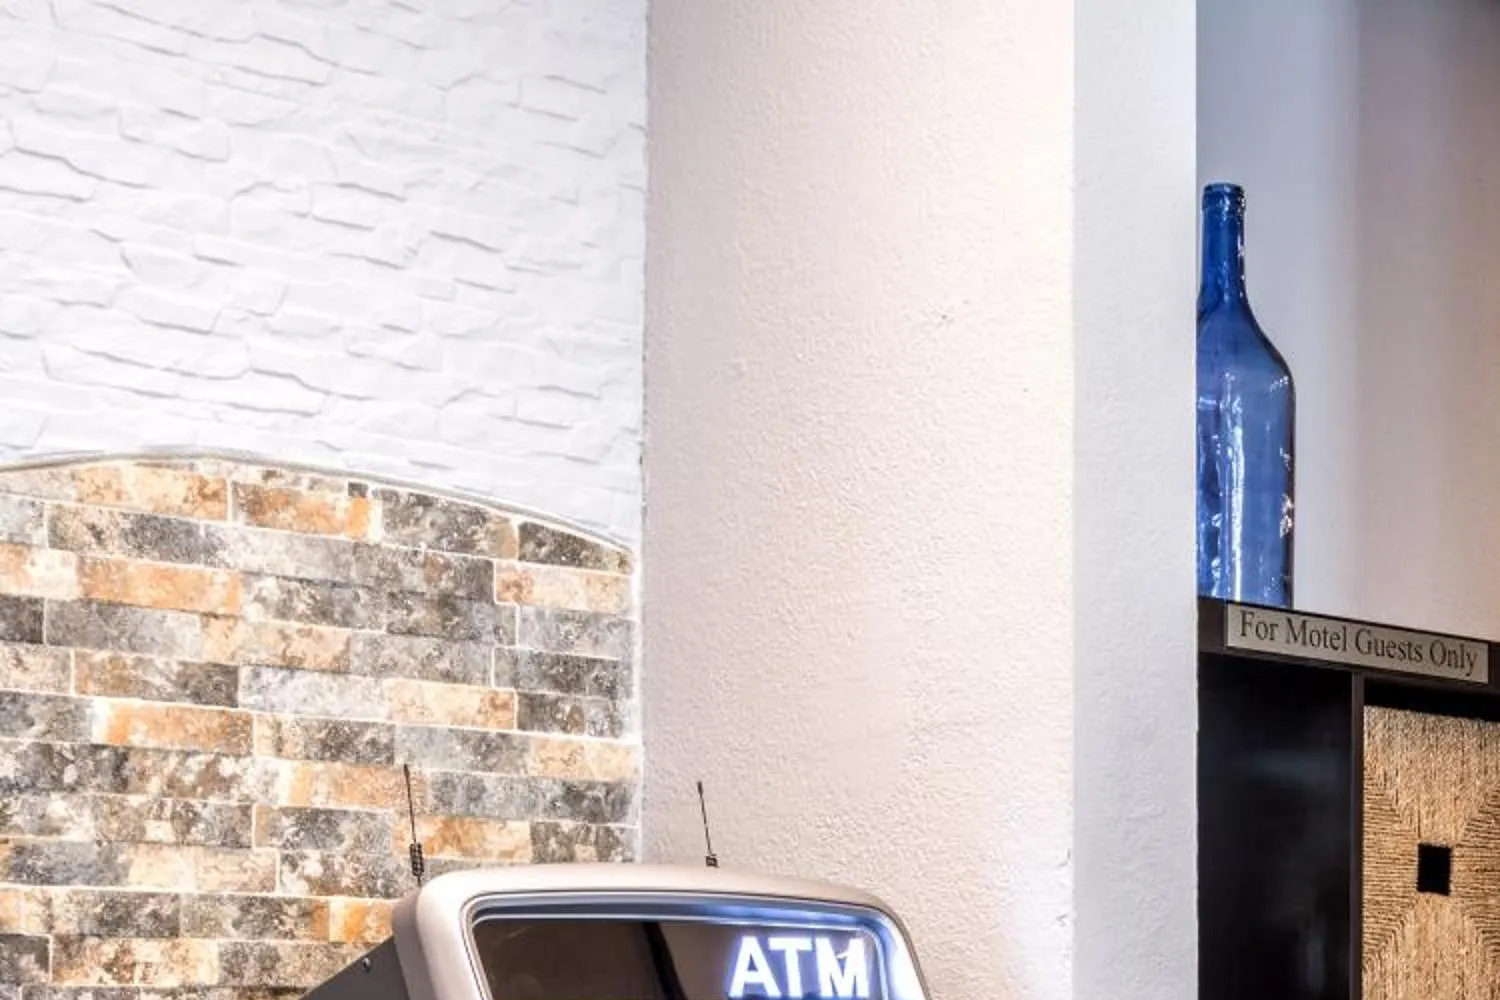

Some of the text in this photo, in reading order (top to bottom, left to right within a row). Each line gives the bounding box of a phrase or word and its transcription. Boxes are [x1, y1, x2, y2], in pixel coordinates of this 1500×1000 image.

[1240, 610, 1478, 677] For Motel Guests Only
[728, 935, 870, 999] ATM
